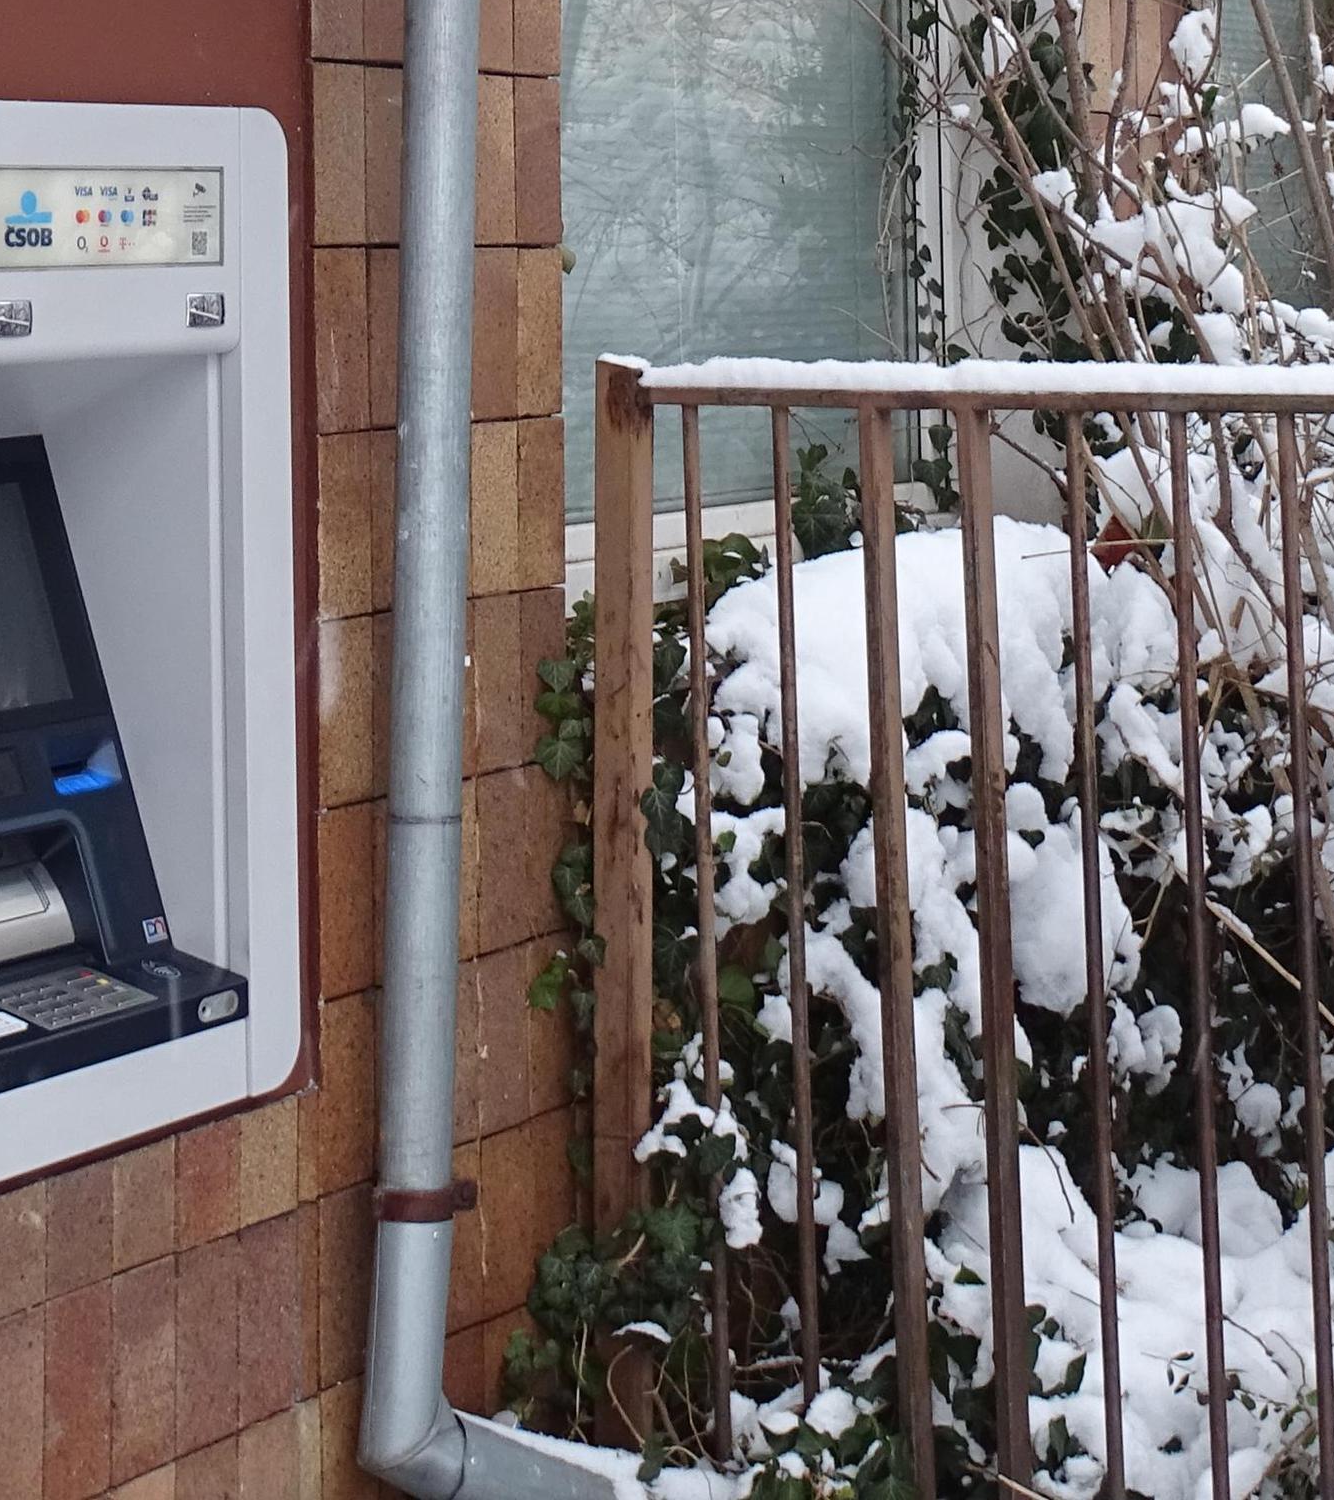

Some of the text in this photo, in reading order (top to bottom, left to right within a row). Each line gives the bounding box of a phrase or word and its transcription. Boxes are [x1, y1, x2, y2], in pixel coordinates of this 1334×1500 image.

[74, 186, 93, 197] VISA
[100, 185, 118, 197] VISA
[4, 226, 53, 248] ČSOB
